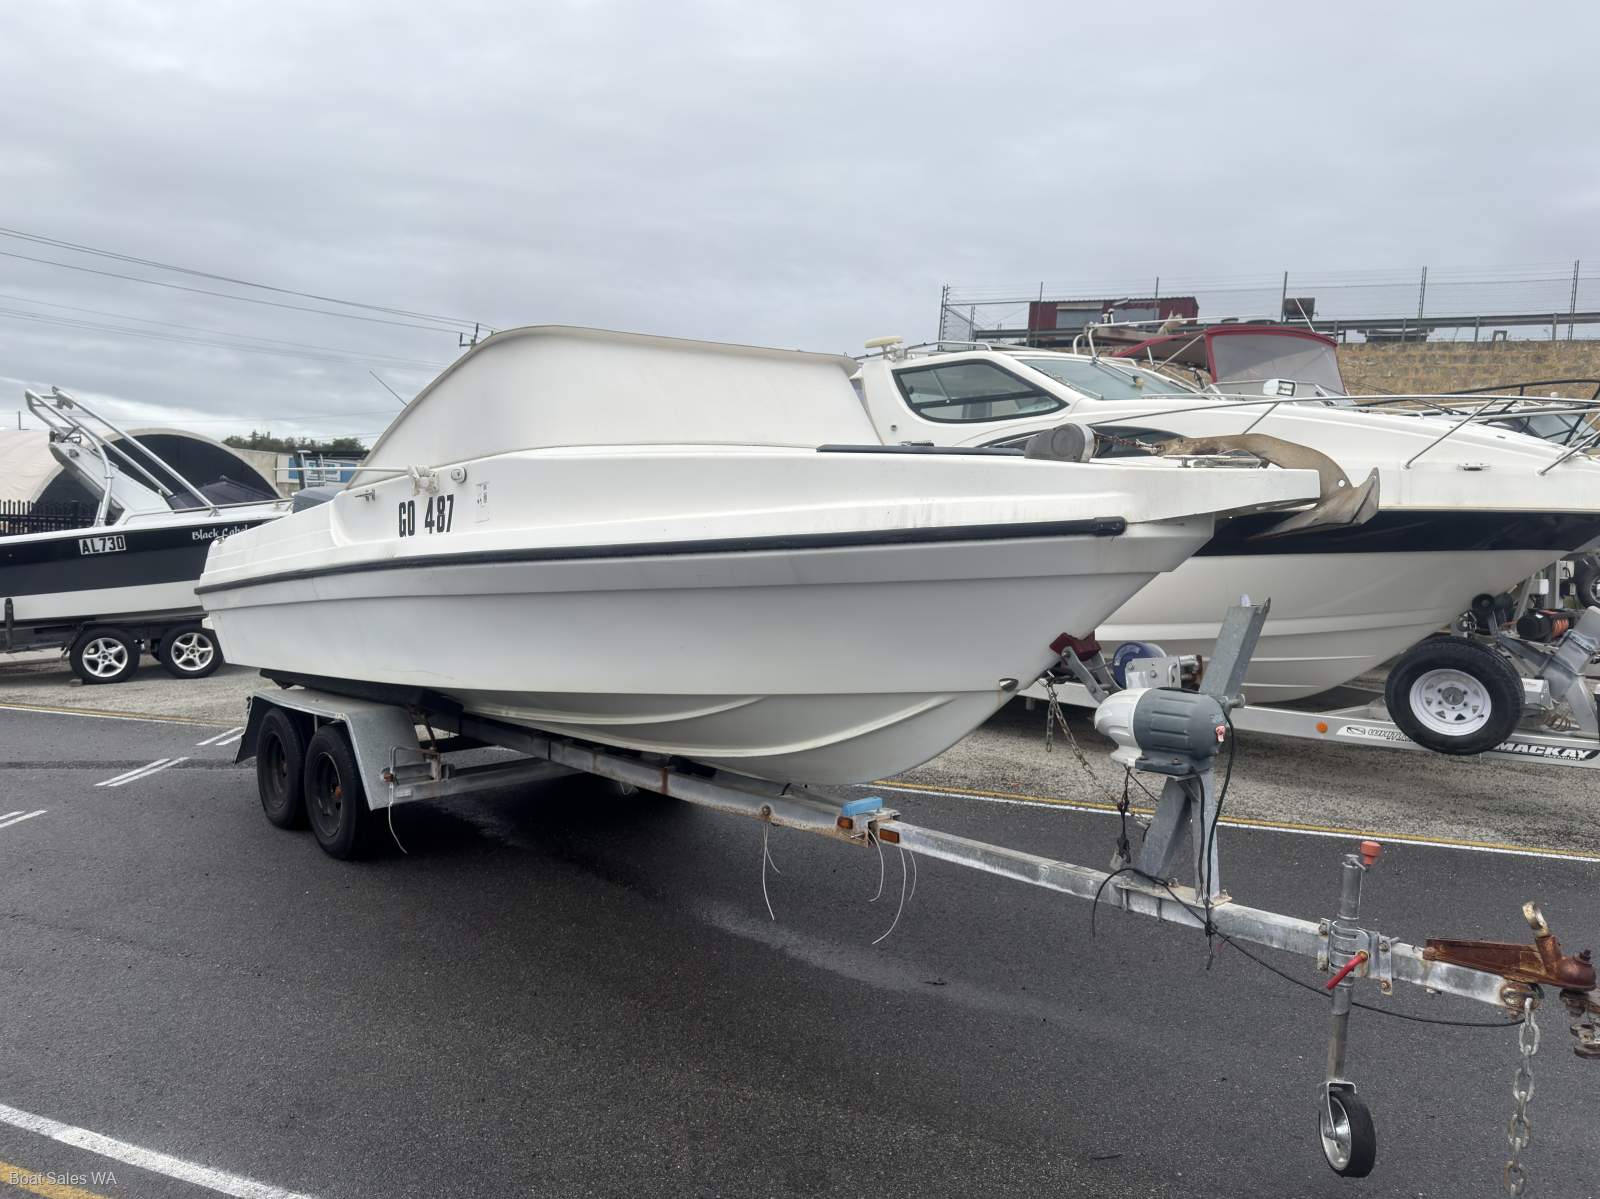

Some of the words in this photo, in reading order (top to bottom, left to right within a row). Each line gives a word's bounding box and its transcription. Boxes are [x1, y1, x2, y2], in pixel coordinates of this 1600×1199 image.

[398, 500, 415, 537] GO
[425, 494, 454, 534] 487
[192, 528, 218, 540] Black
[82, 536, 125, 554] AL730
[1494, 742, 1591, 759] MACKAY
